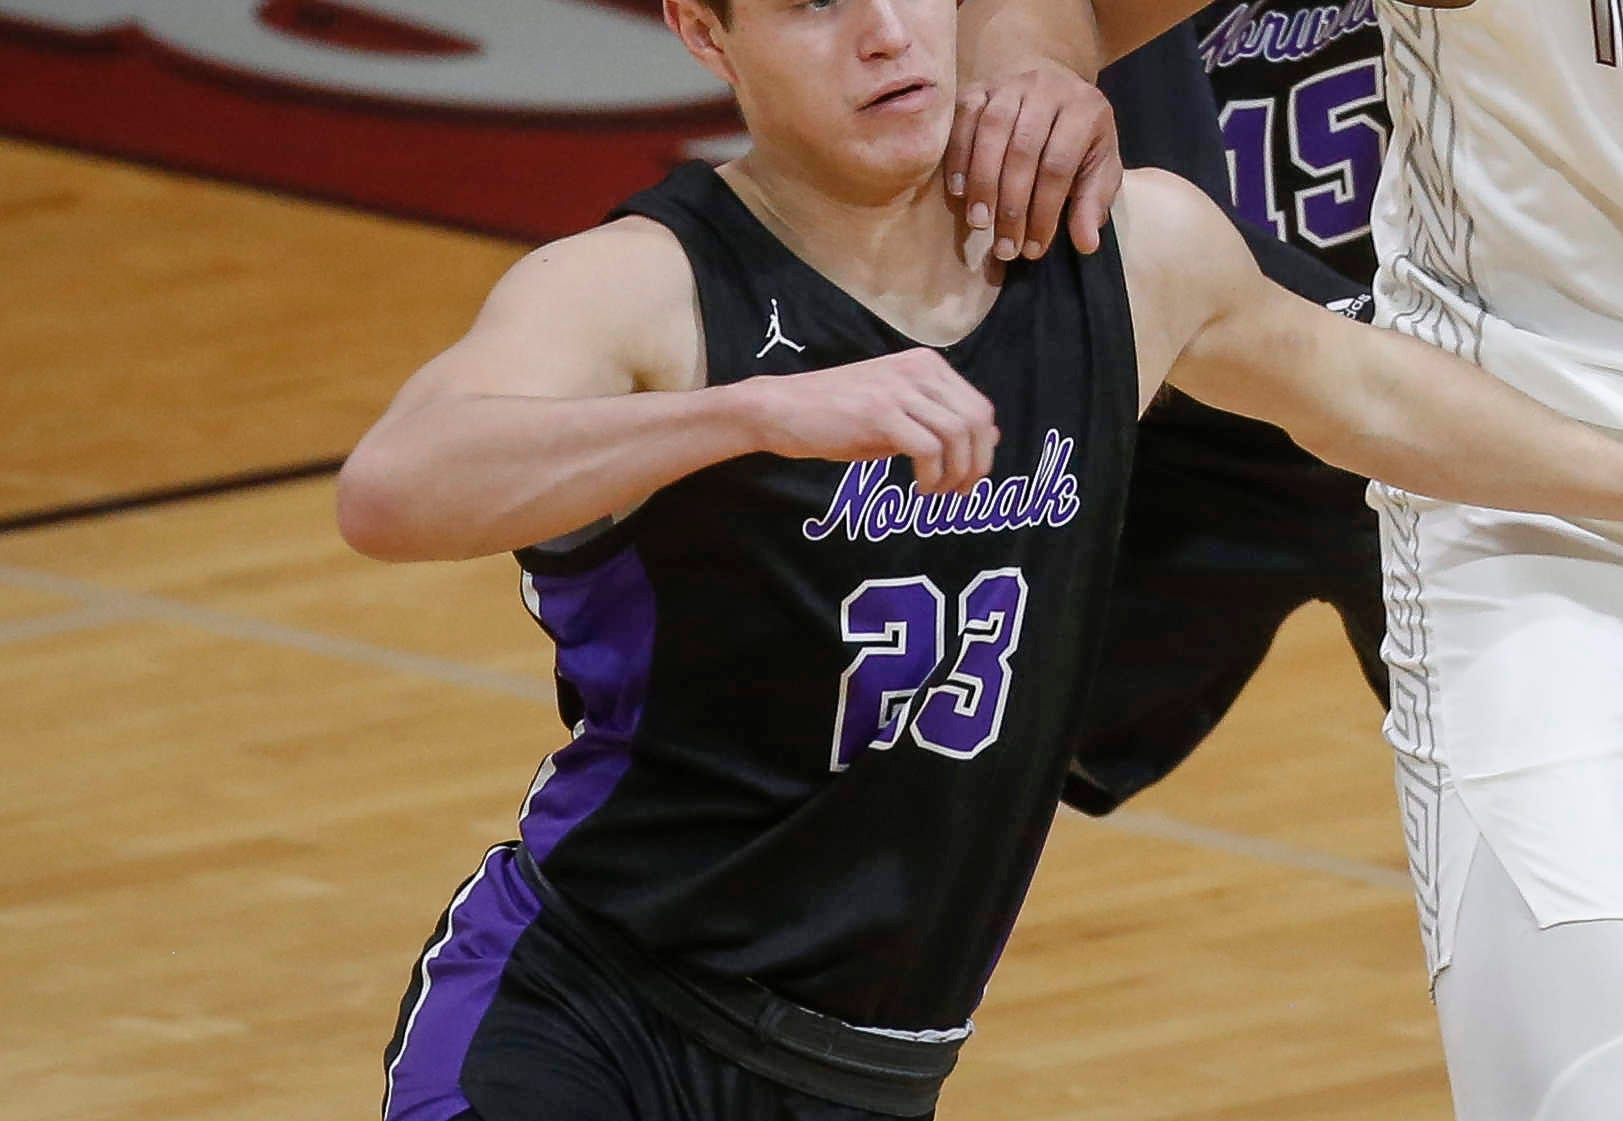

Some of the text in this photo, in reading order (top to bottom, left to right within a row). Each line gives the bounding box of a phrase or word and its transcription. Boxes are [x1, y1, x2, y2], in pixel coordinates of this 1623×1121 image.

[1217, 55, 1387, 248] 15
[802, 428, 1080, 542] Norwalk
[829, 566, 1029, 772] 23
